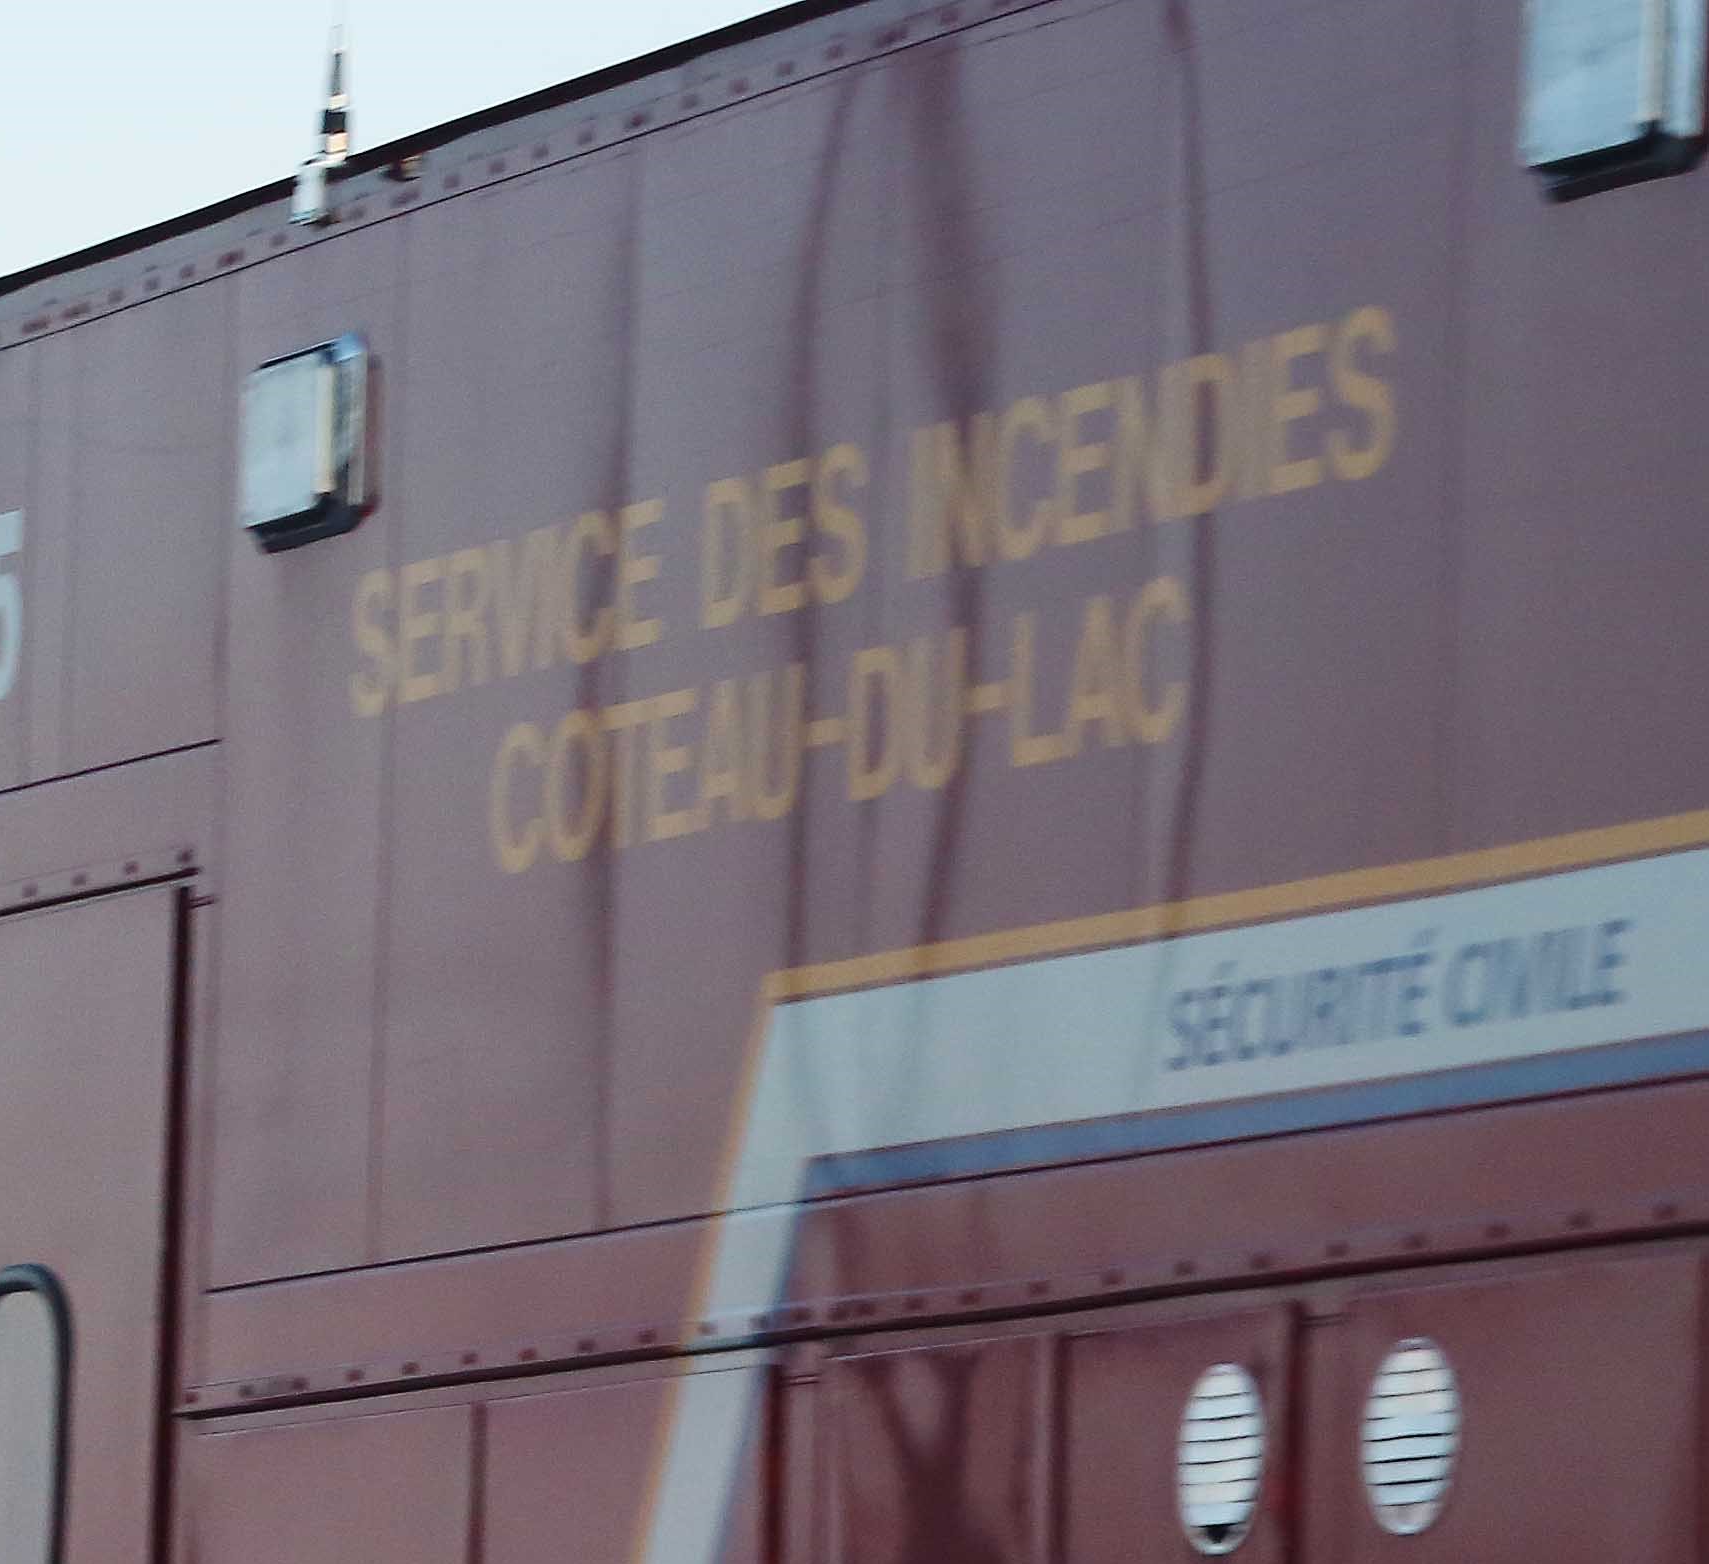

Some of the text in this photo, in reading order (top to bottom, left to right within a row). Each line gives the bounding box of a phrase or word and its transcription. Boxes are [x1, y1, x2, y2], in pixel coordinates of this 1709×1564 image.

[349, 304, 1397, 719] SERVICE DES INCENDIES
[486, 576, 1193, 875] COTEAU-DU-LAC
[1165, 917, 1635, 1071] SÉCURITÉ CIVILE
